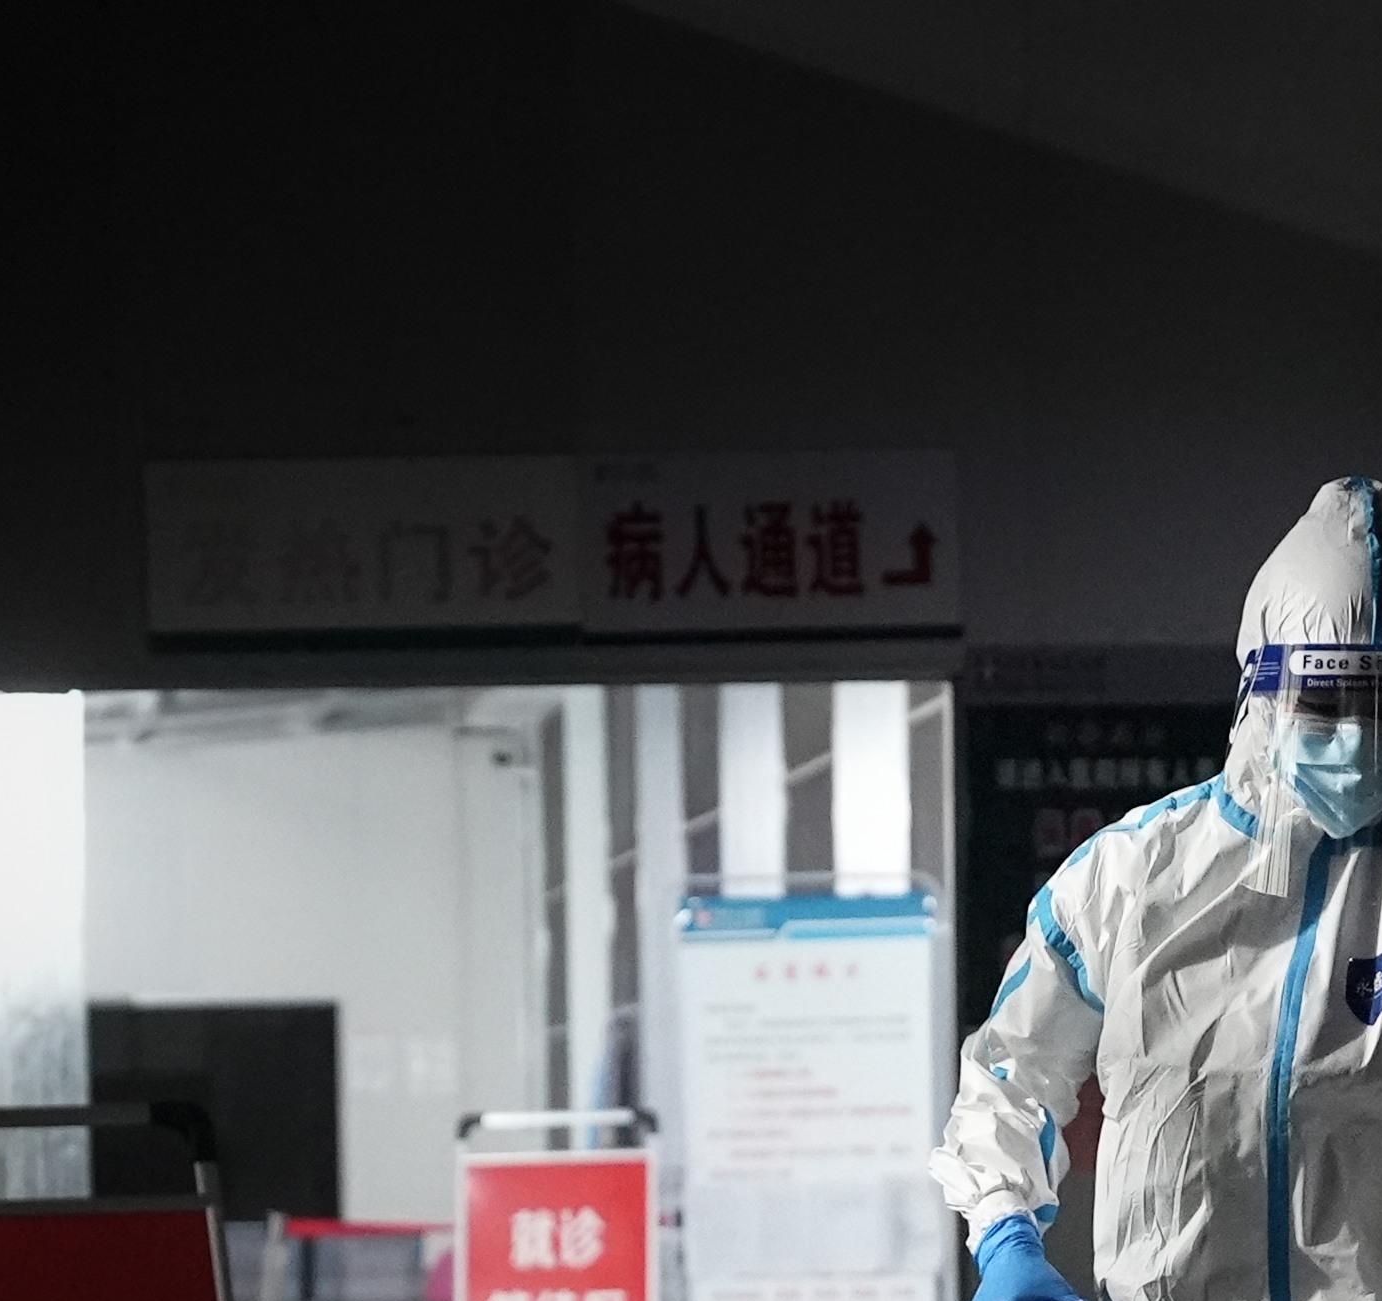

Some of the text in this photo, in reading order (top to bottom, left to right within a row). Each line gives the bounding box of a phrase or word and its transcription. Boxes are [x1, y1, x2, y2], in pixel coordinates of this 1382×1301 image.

[605, 499, 864, 602] 病人通道
[1303, 654, 1349, 670] Face
[1307, 678, 1334, 688] Direct
